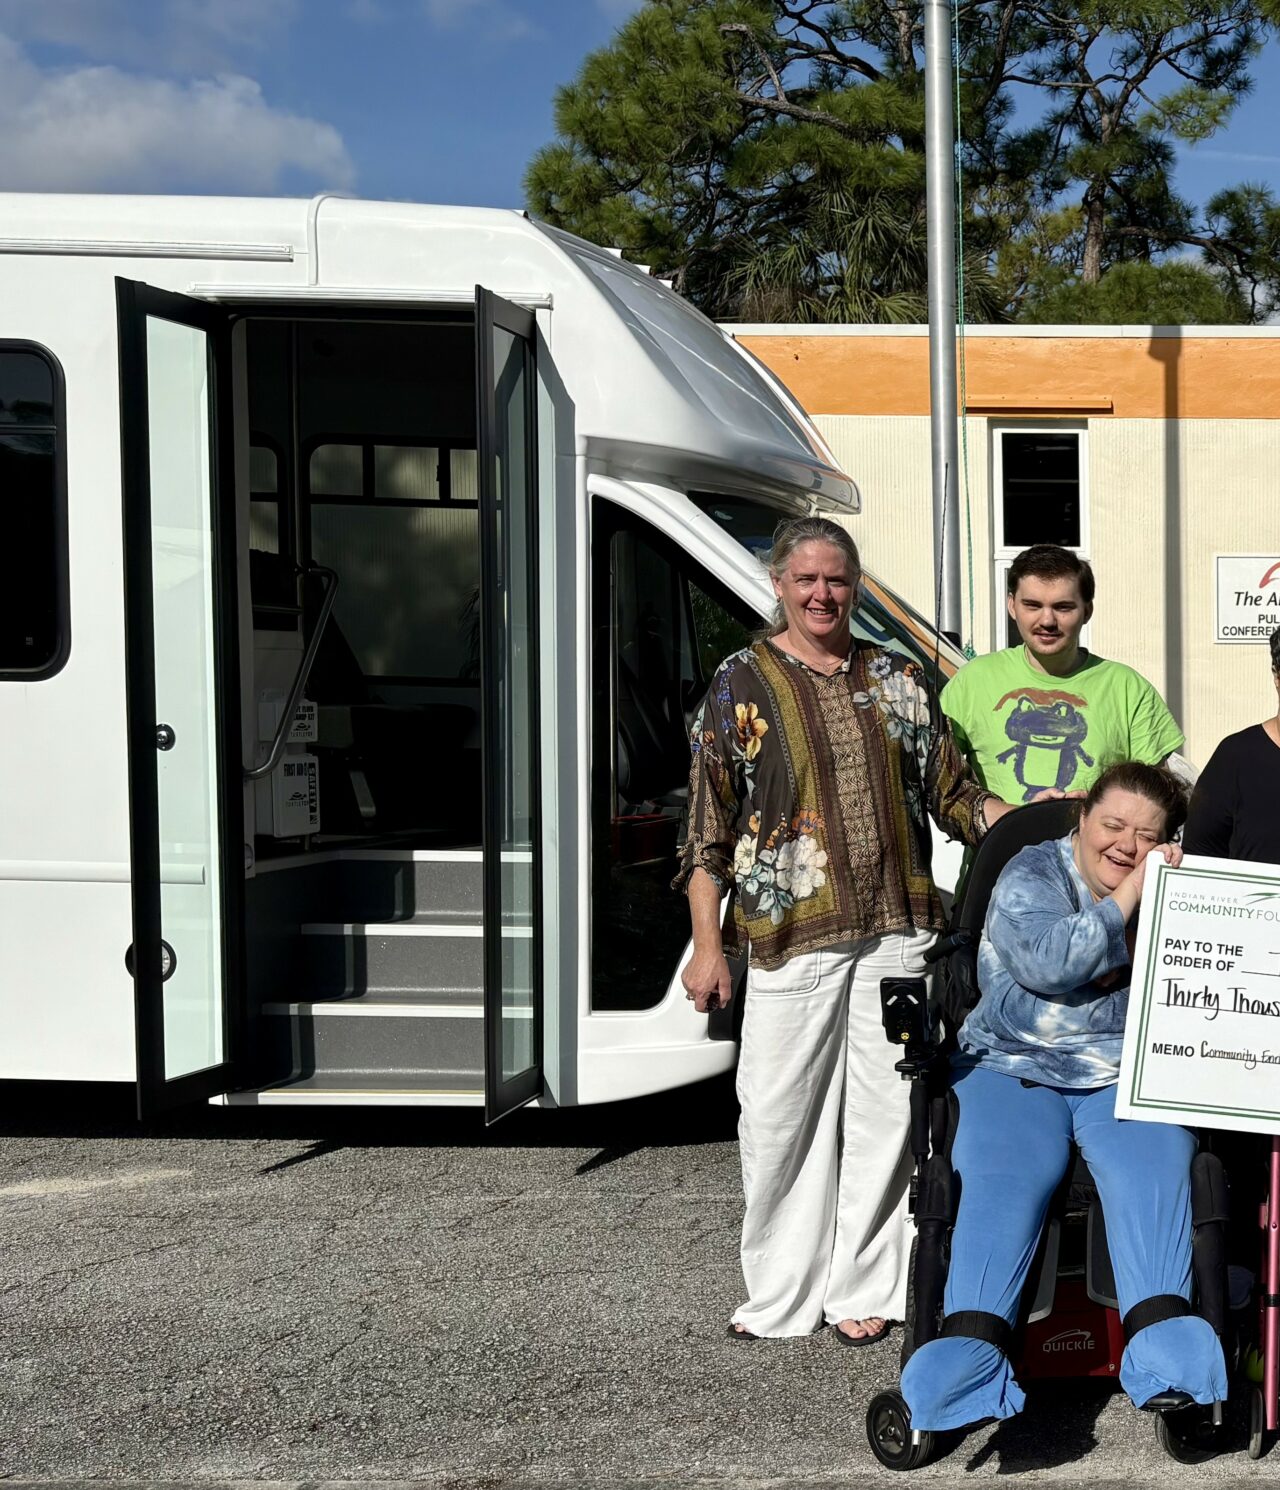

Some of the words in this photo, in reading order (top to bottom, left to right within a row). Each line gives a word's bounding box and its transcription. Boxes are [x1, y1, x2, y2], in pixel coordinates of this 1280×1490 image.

[1234, 591, 1262, 606] The
[308, 767, 317, 808] SAFETY
[1170, 891, 1205, 901] INDIAN
[1210, 895, 1239, 904] RIVER
[1168, 900, 1255, 919] COMMUNITY
[1164, 938, 1191, 951] PAY
[1194, 941, 1213, 954] TO
[1217, 943, 1244, 957] THE
[1162, 954, 1212, 970] ORDER
[1216, 960, 1236, 972] OF
[1161, 978, 1220, 1021] Thirty
[1151, 1043, 1196, 1058] MEMO
[1200, 1040, 1257, 1070] Community
[1042, 1340, 1096, 1353] QUICKIE
